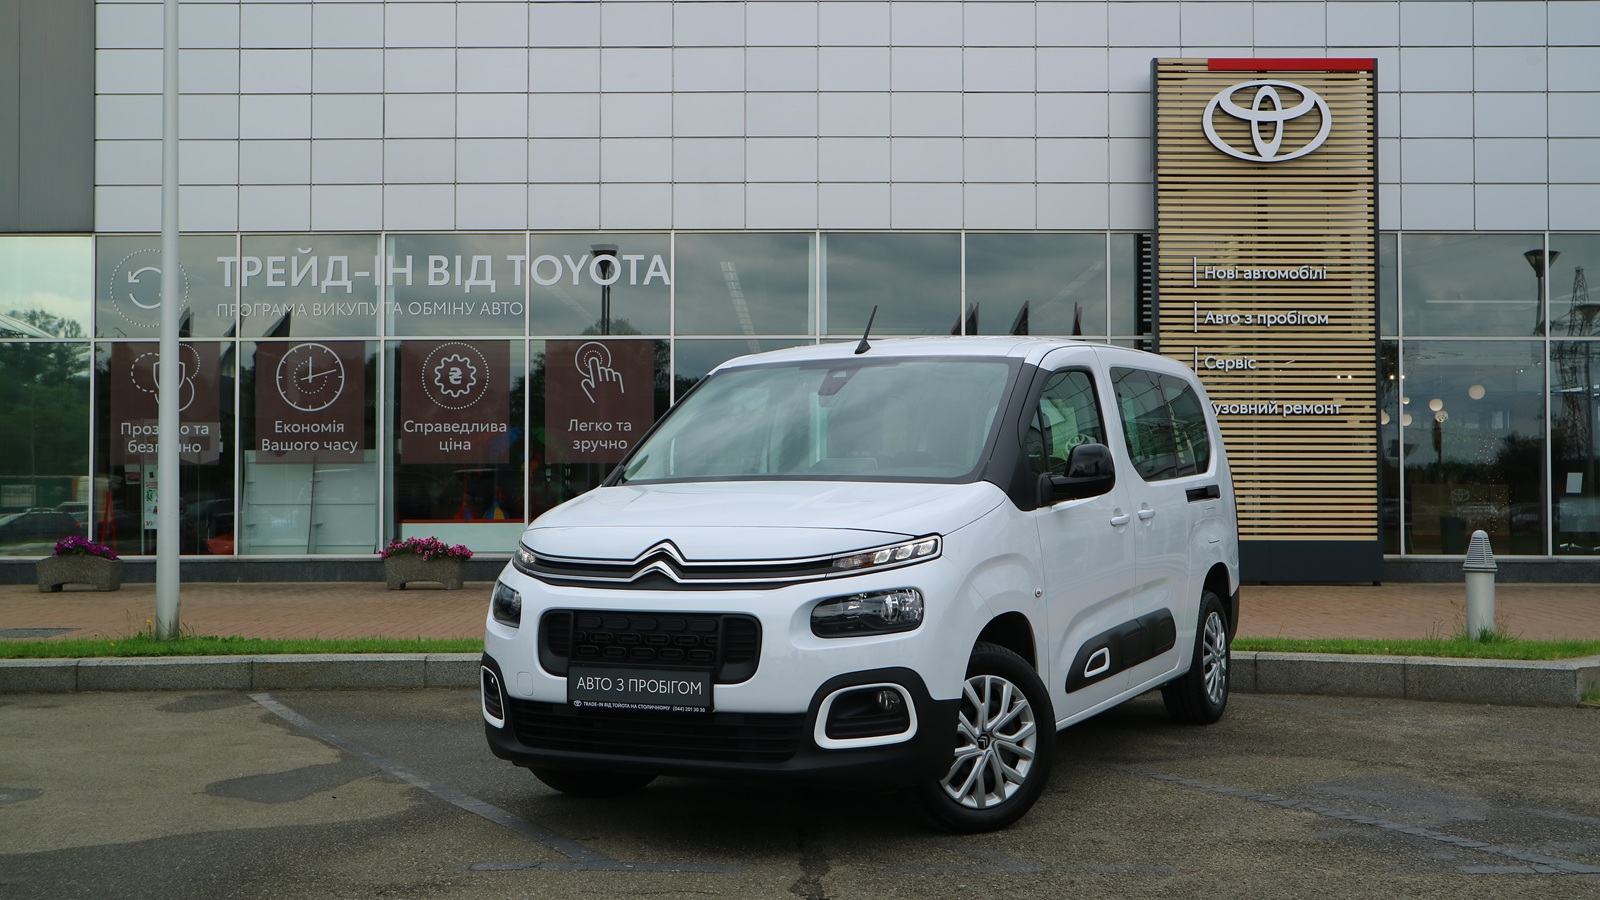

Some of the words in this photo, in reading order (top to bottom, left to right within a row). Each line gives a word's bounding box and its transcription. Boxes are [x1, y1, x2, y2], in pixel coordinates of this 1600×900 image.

[216, 247, 413, 294] ТРЕЙД-ІН
[428, 255, 496, 294] ВІД
[507, 254, 671, 286] TOYOTA
[1204, 266, 1239, 280] Нові
[1243, 265, 1327, 280] автомобілі
[217, 303, 308, 317] ПРОГРАМА
[313, 302, 381, 316] ВИКУПУ
[384, 302, 403, 315] ТА
[408, 301, 475, 316] ОБМІНУ
[479, 301, 523, 316] АВТО
[1204, 311, 1241, 325] Авто
[1244, 313, 1253, 325] з
[1257, 310, 1329, 328] пробігом
[1204, 356, 1257, 372] Сервіс
[1211, 401, 1278, 416] узовний
[1283, 404, 1342, 418] ремонт
[121, 422, 190, 438] Прозо
[193, 425, 209, 435] та
[274, 420, 345, 433] Економія
[403, 420, 507, 435] Справедлива
[567, 419, 613, 432] Легко
[616, 421, 632, 432] та
[127, 440, 202, 453] безно
[261, 439, 320, 451] Вашого
[323, 441, 358, 453] часу
[439, 438, 471, 453] ціна
[572, 440, 628, 452] зручно
[576, 677, 612, 690] АВТО
[628, 678, 702, 695] ПРОБІГОМ
